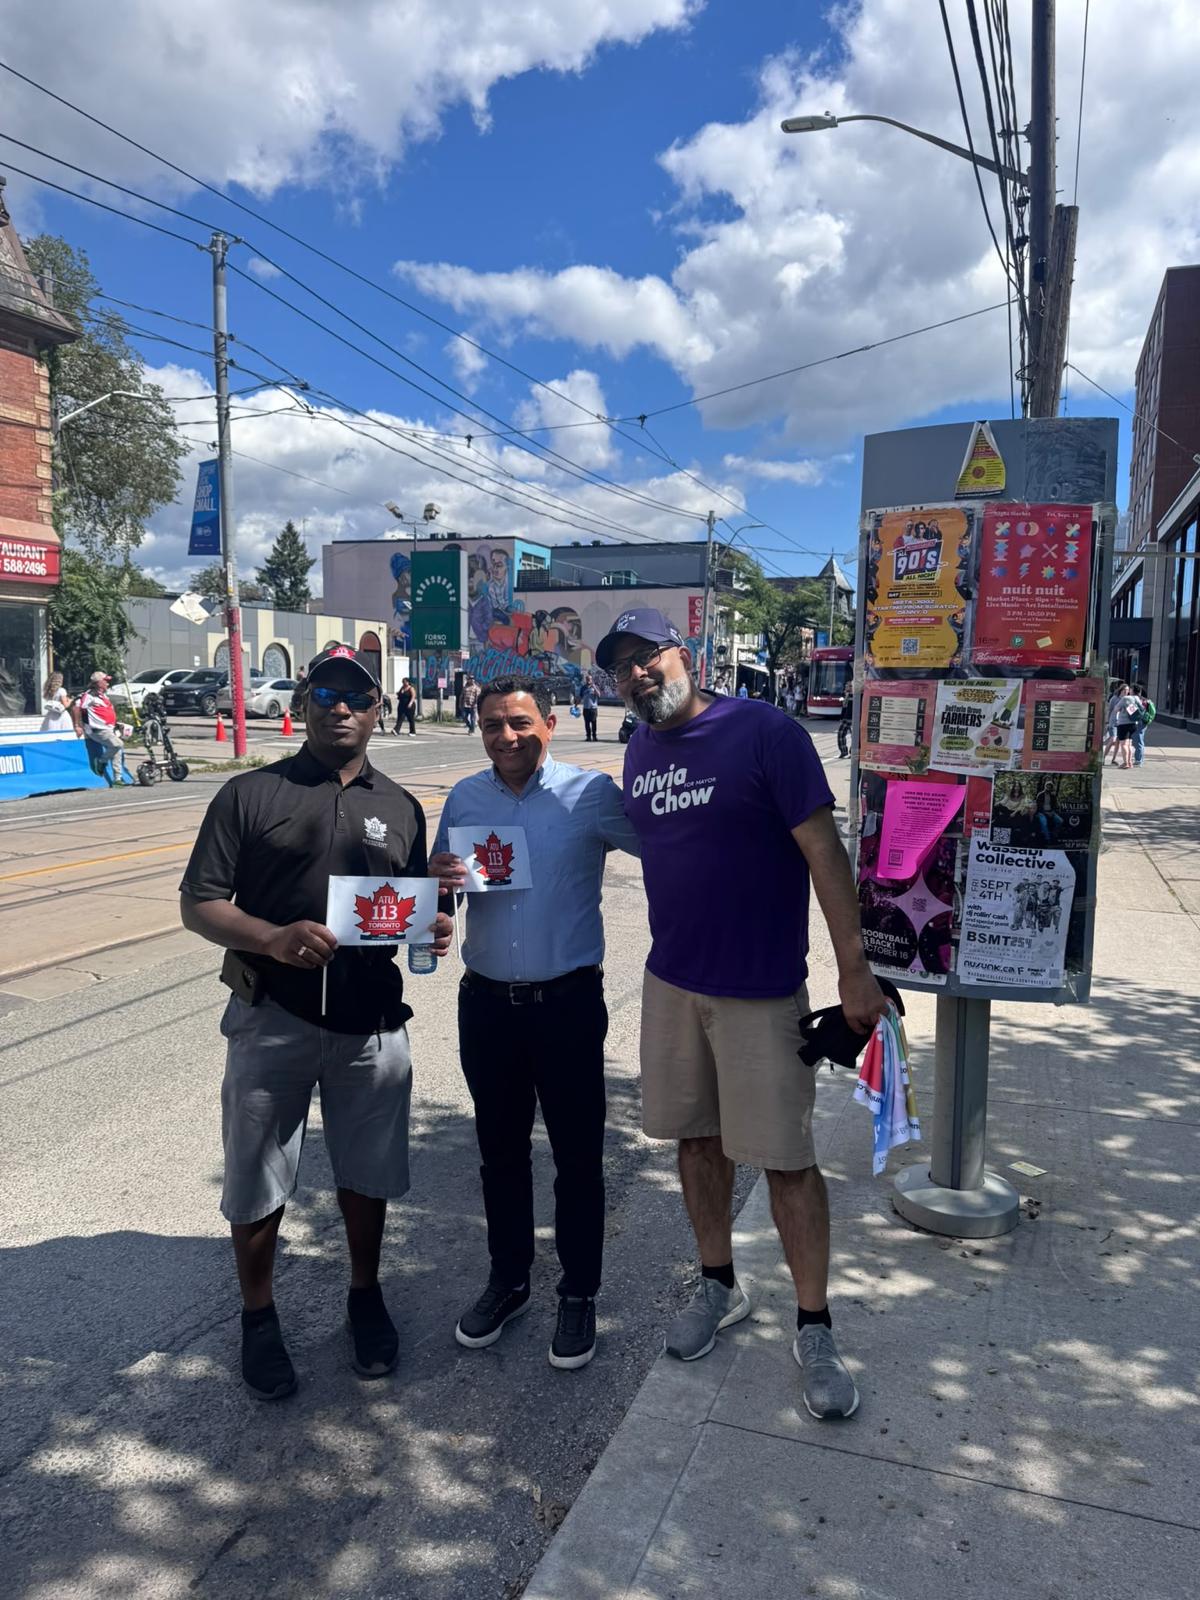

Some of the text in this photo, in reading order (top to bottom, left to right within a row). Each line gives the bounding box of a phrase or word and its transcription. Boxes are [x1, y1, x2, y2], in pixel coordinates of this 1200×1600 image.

[1002, 583, 1065, 596] nuit nuit
[424, 633, 447, 641] FORNO
[940, 711, 986, 729] FARMERS'
[942, 724, 969, 737] Market
[632, 763, 688, 798] Olivia
[695, 776, 717, 786] MAYOR
[651, 785, 715, 816] Chow
[487, 851, 504, 866] 113
[975, 853, 1056, 870] collective
[980, 879, 1012, 891] SEPT
[378, 895, 395, 904] ATU
[979, 890, 1003, 902] 4TH
[371, 904, 399, 920] 113
[861, 927, 910, 946] BOOBYBALL
[870, 938, 896, 951] BACK!
